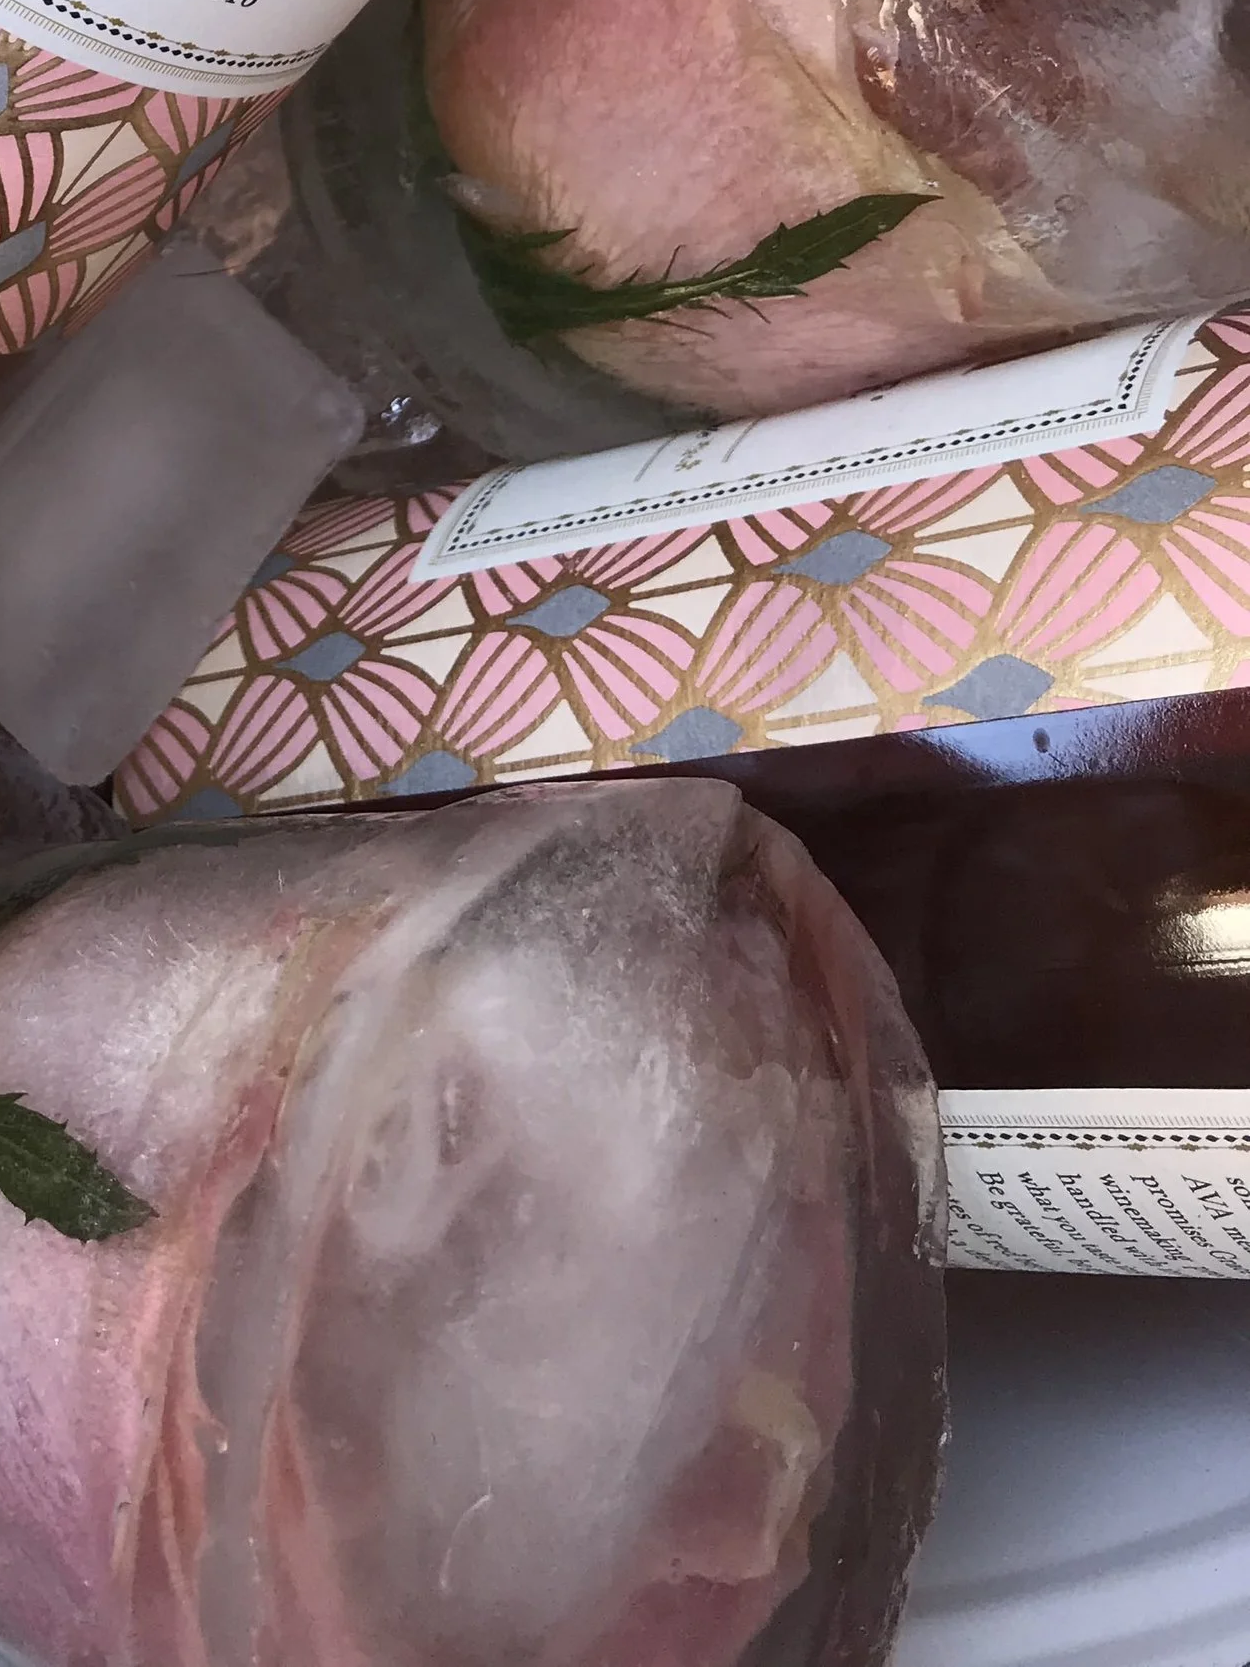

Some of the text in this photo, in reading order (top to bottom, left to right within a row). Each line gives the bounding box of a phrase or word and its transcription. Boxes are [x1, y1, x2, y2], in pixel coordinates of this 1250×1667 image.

[976, 1171, 1005, 1196] Be
[1017, 1171, 1061, 1213] what
[1041, 1215, 1087, 1241] you
[1055, 1173, 1138, 1244] handled
[1099, 1173, 1193, 1262] winemaking
[1129, 1174, 1214, 1249] promises
[1180, 1173, 1234, 1221] AVA
[990, 1200, 1075, 1256] grateful.
